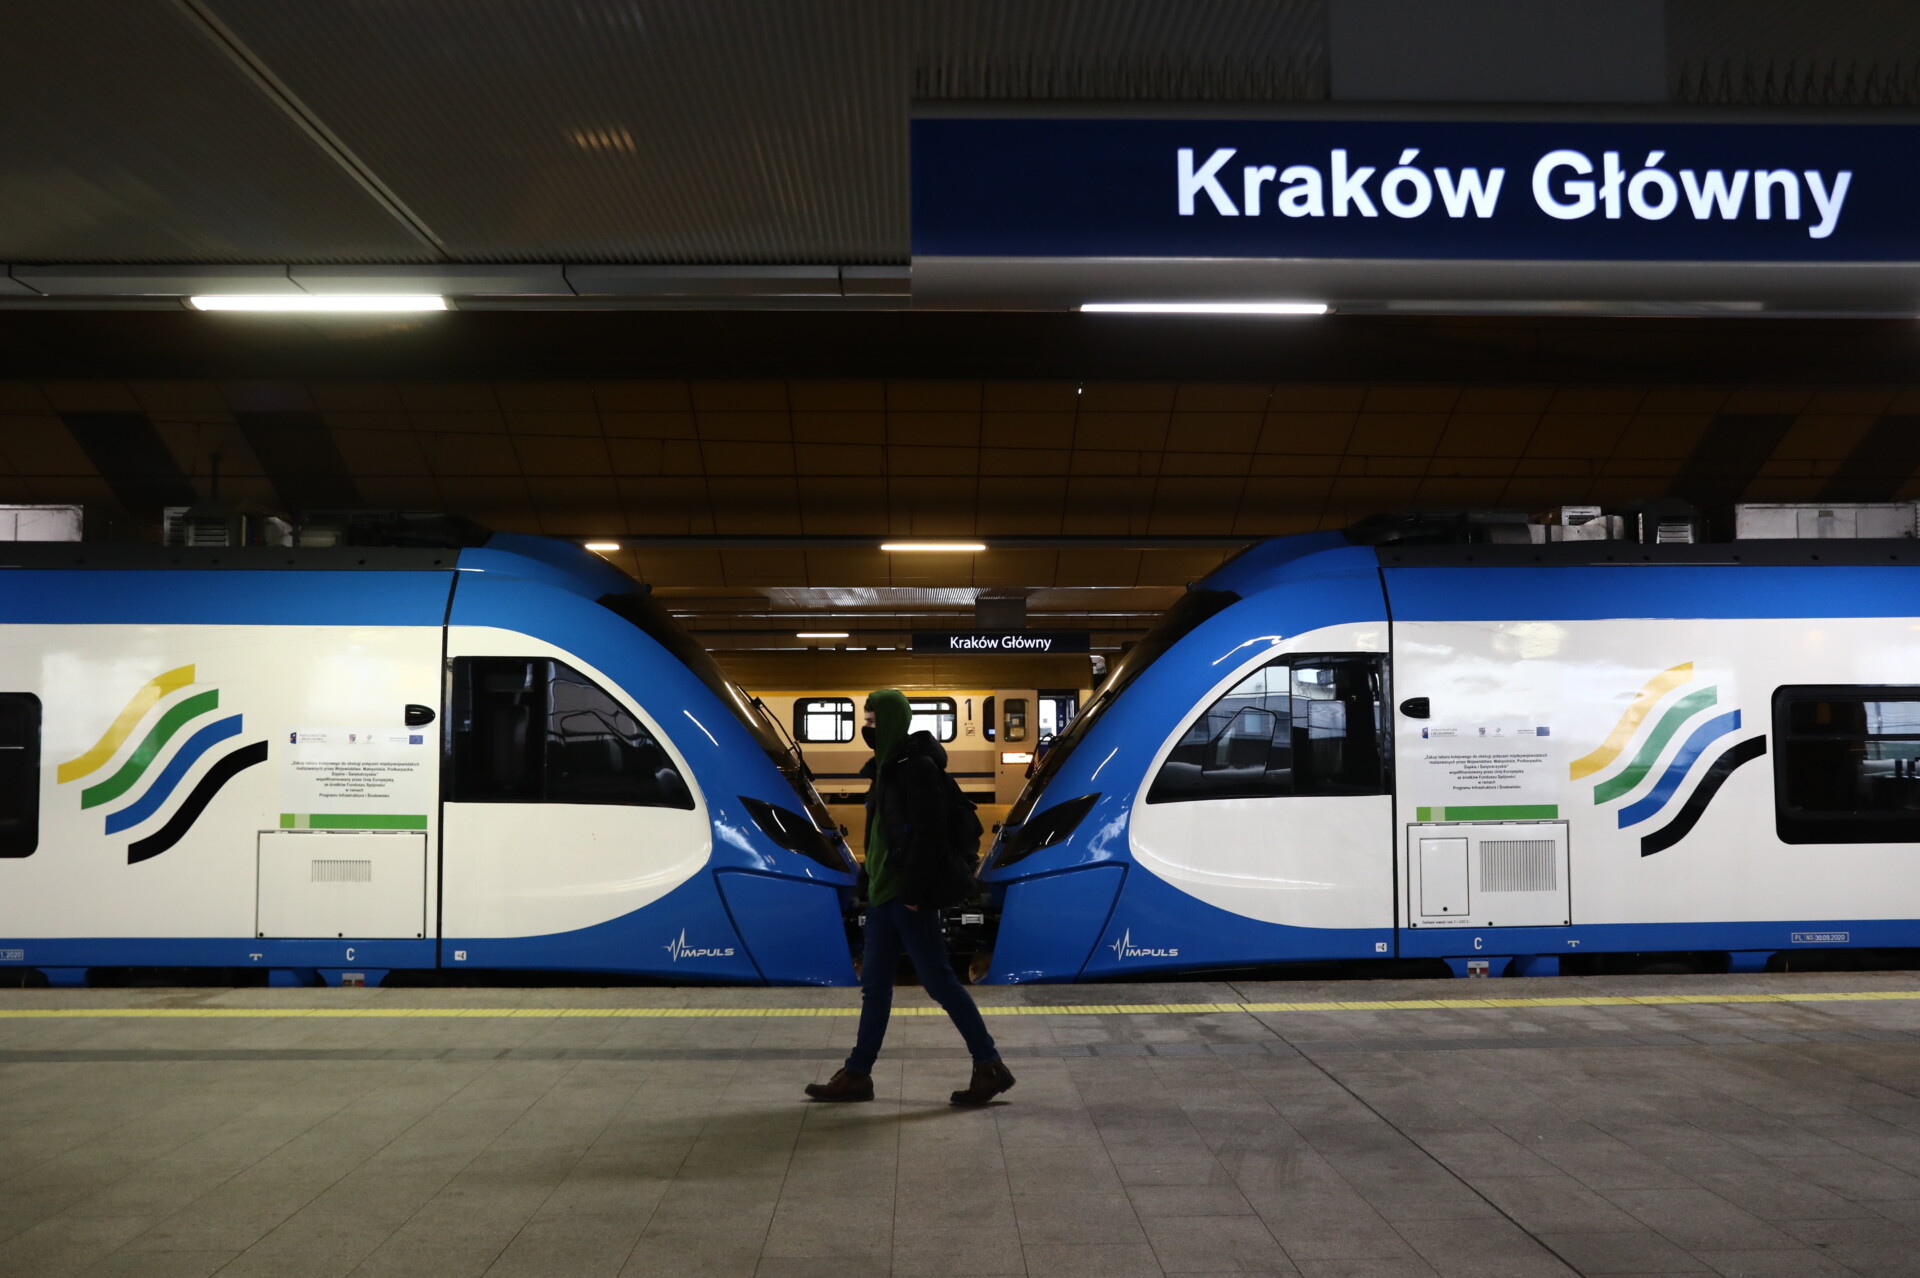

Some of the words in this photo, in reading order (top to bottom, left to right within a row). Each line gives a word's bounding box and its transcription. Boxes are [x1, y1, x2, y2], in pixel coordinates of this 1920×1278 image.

[1177, 148, 1505, 218] Kraków
[1532, 149, 1853, 240] Główny
[950, 636, 998, 649] Kraków
[1002, 636, 1051, 651] Główny
[965, 699, 972, 721] 1
[1474, 937, 1482, 950] C
[346, 947, 355, 961] C
[680, 948, 735, 957] IMPULS
[1125, 948, 1179, 957] IMPULS
